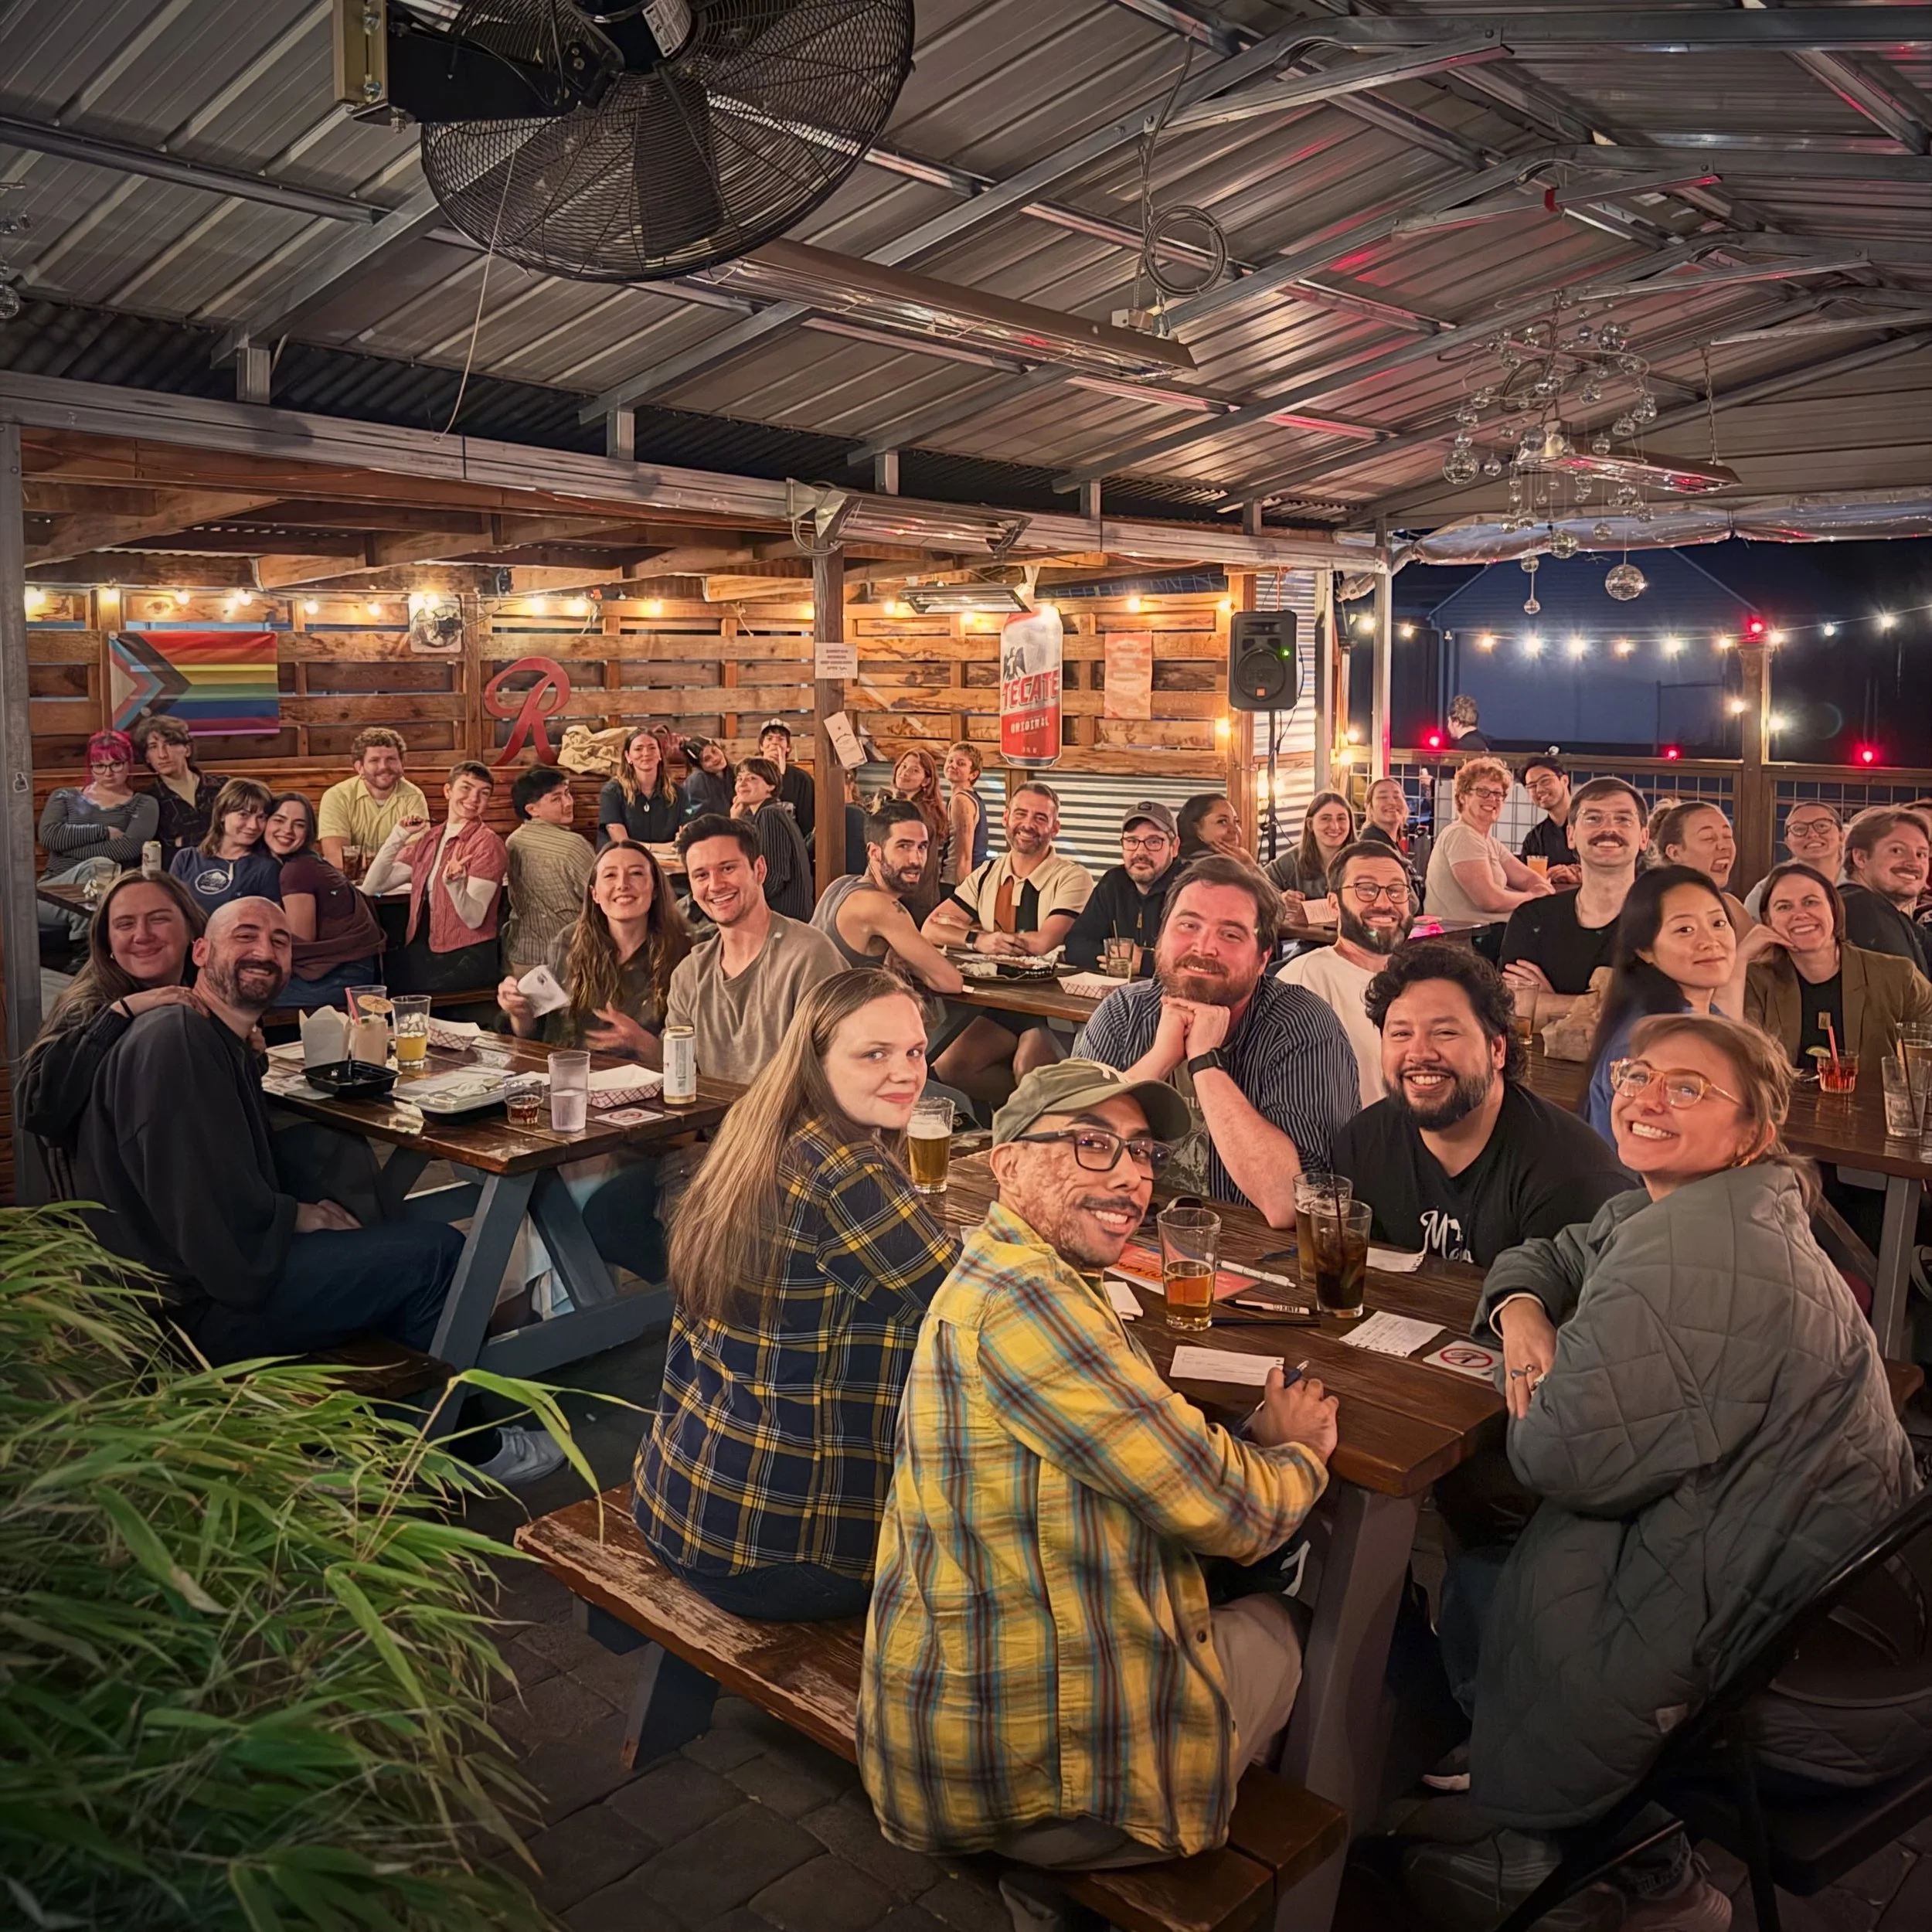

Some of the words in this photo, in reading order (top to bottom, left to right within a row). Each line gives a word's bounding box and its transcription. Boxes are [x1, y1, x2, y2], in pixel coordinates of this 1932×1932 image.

[1002, 668, 1059, 708] TECATE
[484, 656, 570, 767] R
[1010, 716, 1049, 734] ORIGINAL
